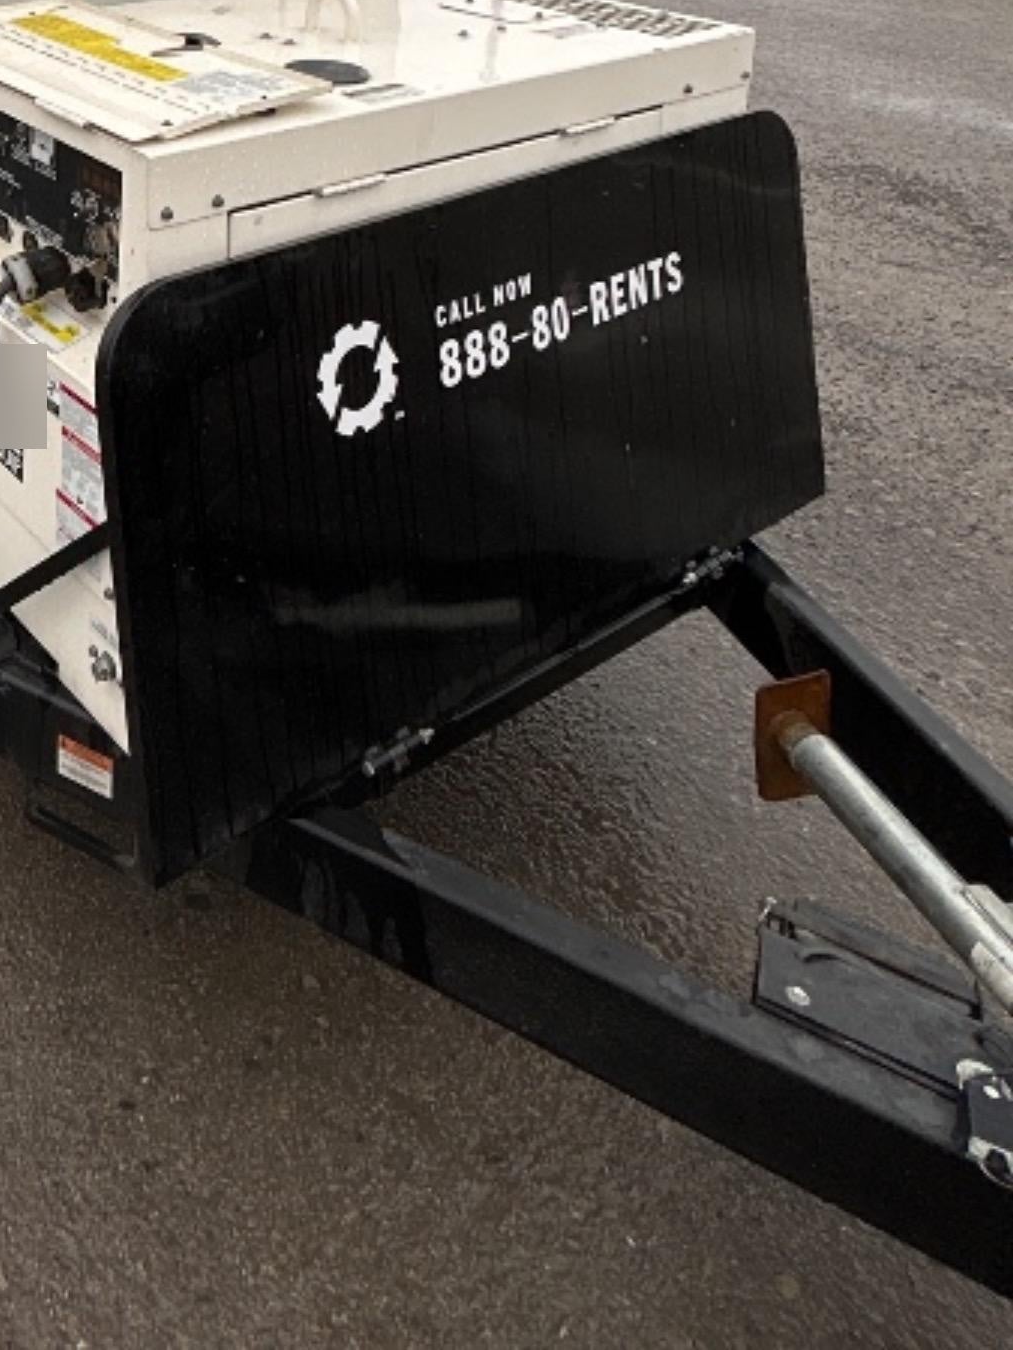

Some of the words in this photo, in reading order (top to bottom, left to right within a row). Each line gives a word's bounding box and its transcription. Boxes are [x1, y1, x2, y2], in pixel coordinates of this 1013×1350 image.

[435, 293, 487, 328] CALL
[492, 272, 532, 307] NOW
[439, 251, 684, 388] 888-80-RENTS
